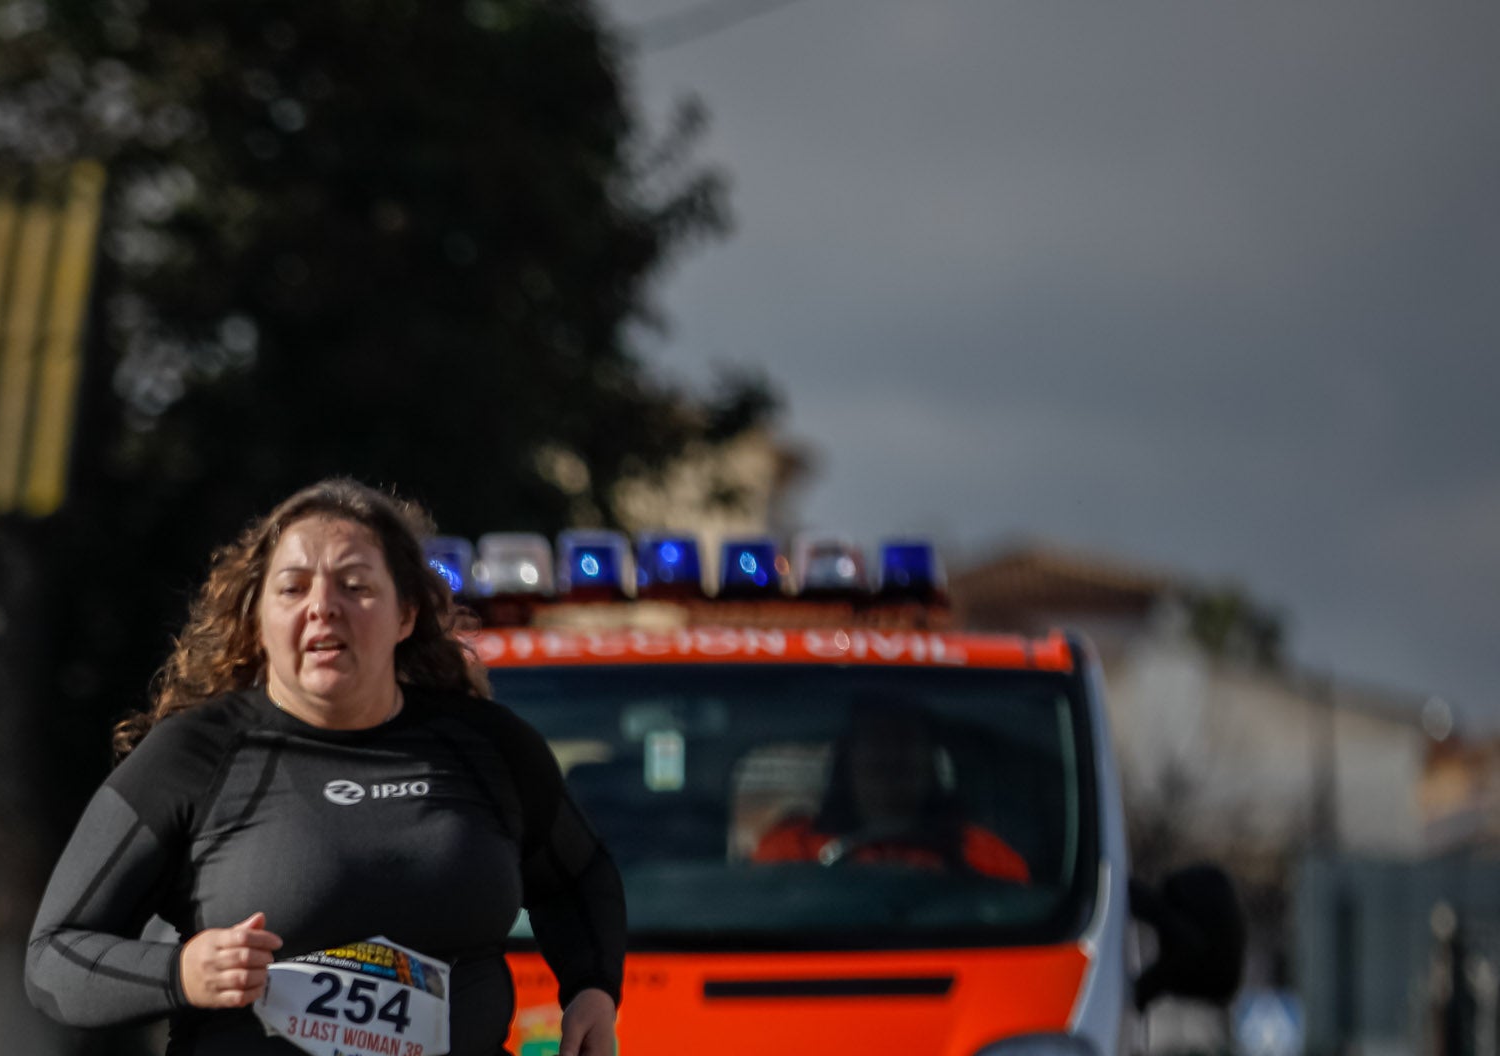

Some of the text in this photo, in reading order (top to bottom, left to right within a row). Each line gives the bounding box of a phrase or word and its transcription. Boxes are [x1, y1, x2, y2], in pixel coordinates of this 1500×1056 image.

[803, 629, 967, 665] CIVIL
[371, 781, 429, 799] IPSO
[325, 949, 393, 967] POPULAR
[305, 972, 412, 1034] 254
[288, 1016, 298, 1036] 3
[301, 1019, 339, 1043] LAST
